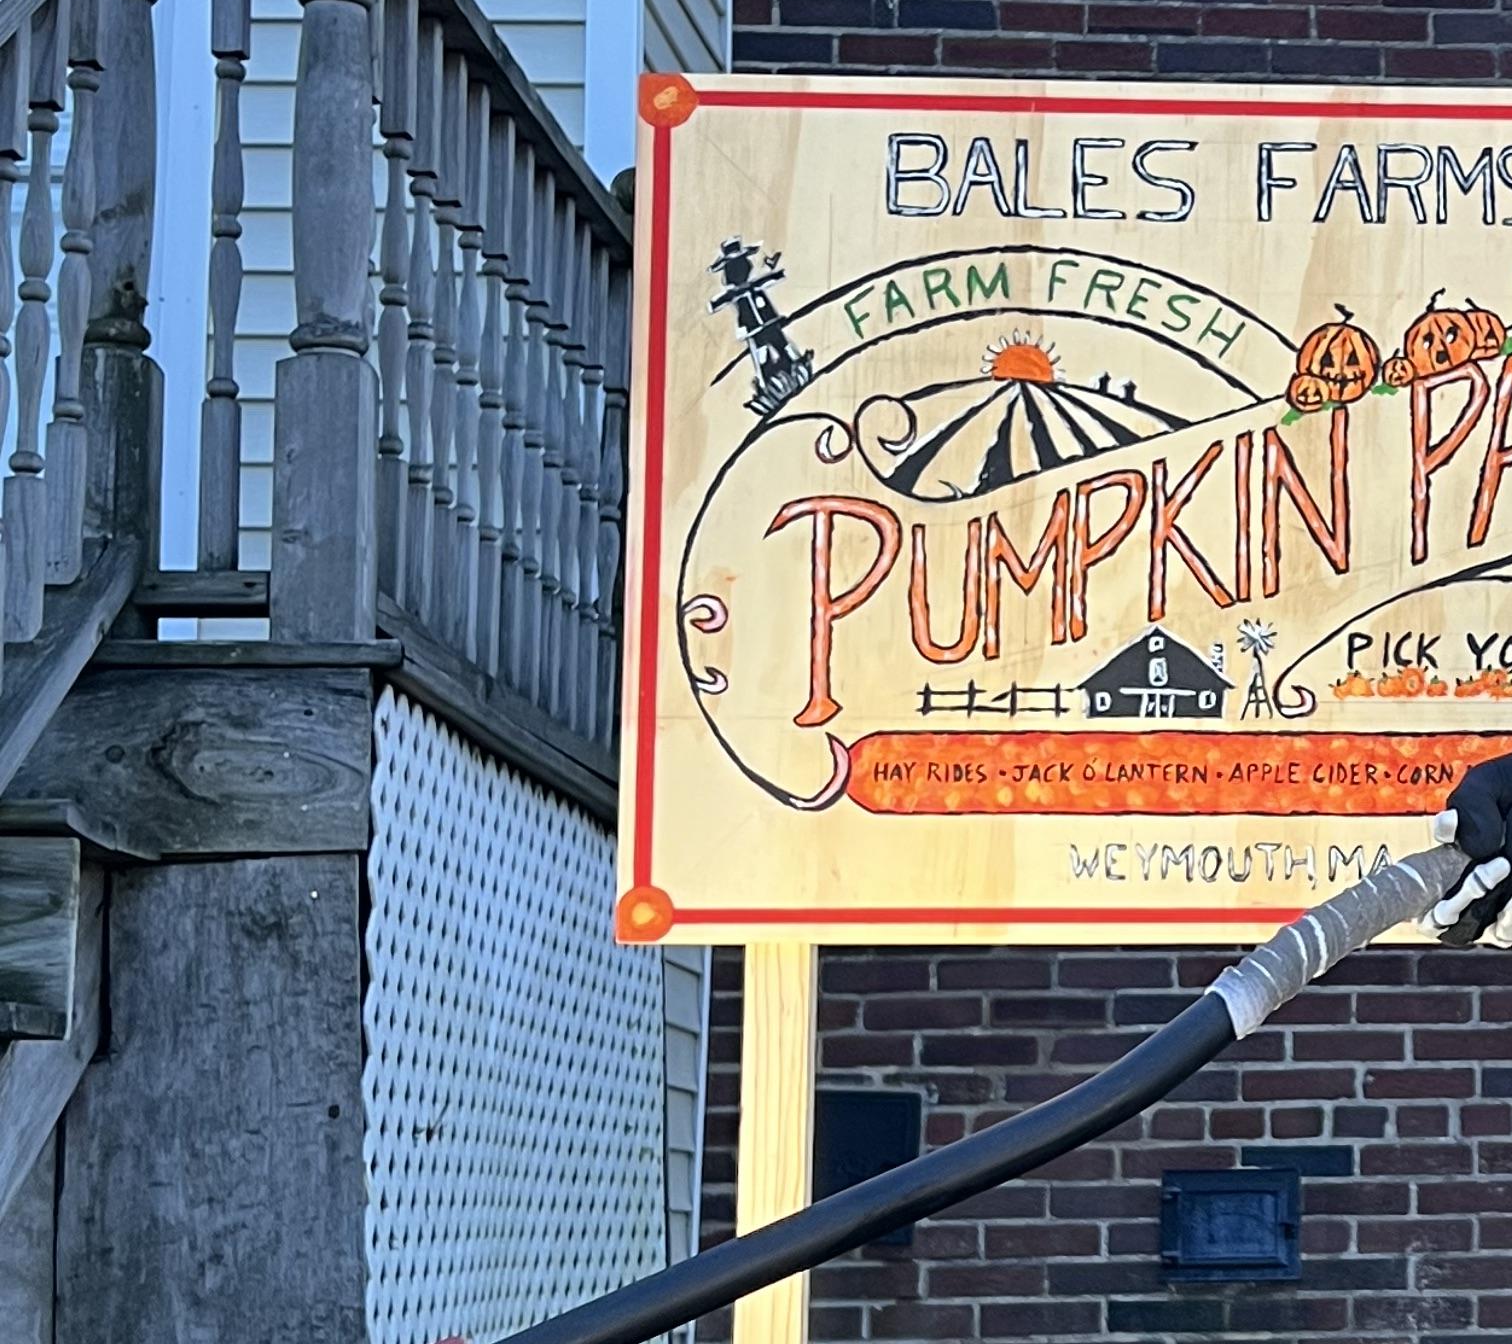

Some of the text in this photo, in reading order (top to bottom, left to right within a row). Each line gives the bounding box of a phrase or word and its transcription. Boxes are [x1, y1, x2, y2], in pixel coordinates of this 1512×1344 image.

[885, 133, 1198, 222] BALES
[844, 260, 1246, 359] FARM FRESH
[764, 405, 1350, 727] PUMPKIN
[1348, 631, 1441, 670] PICK
[874, 762, 916, 783] HAY
[927, 762, 988, 783] RIDES
[1012, 763, 1074, 783] JACK
[1228, 763, 1300, 783] APPLE
[1312, 763, 1379, 784] CIDER
[1398, 764, 1454, 784] CORN
